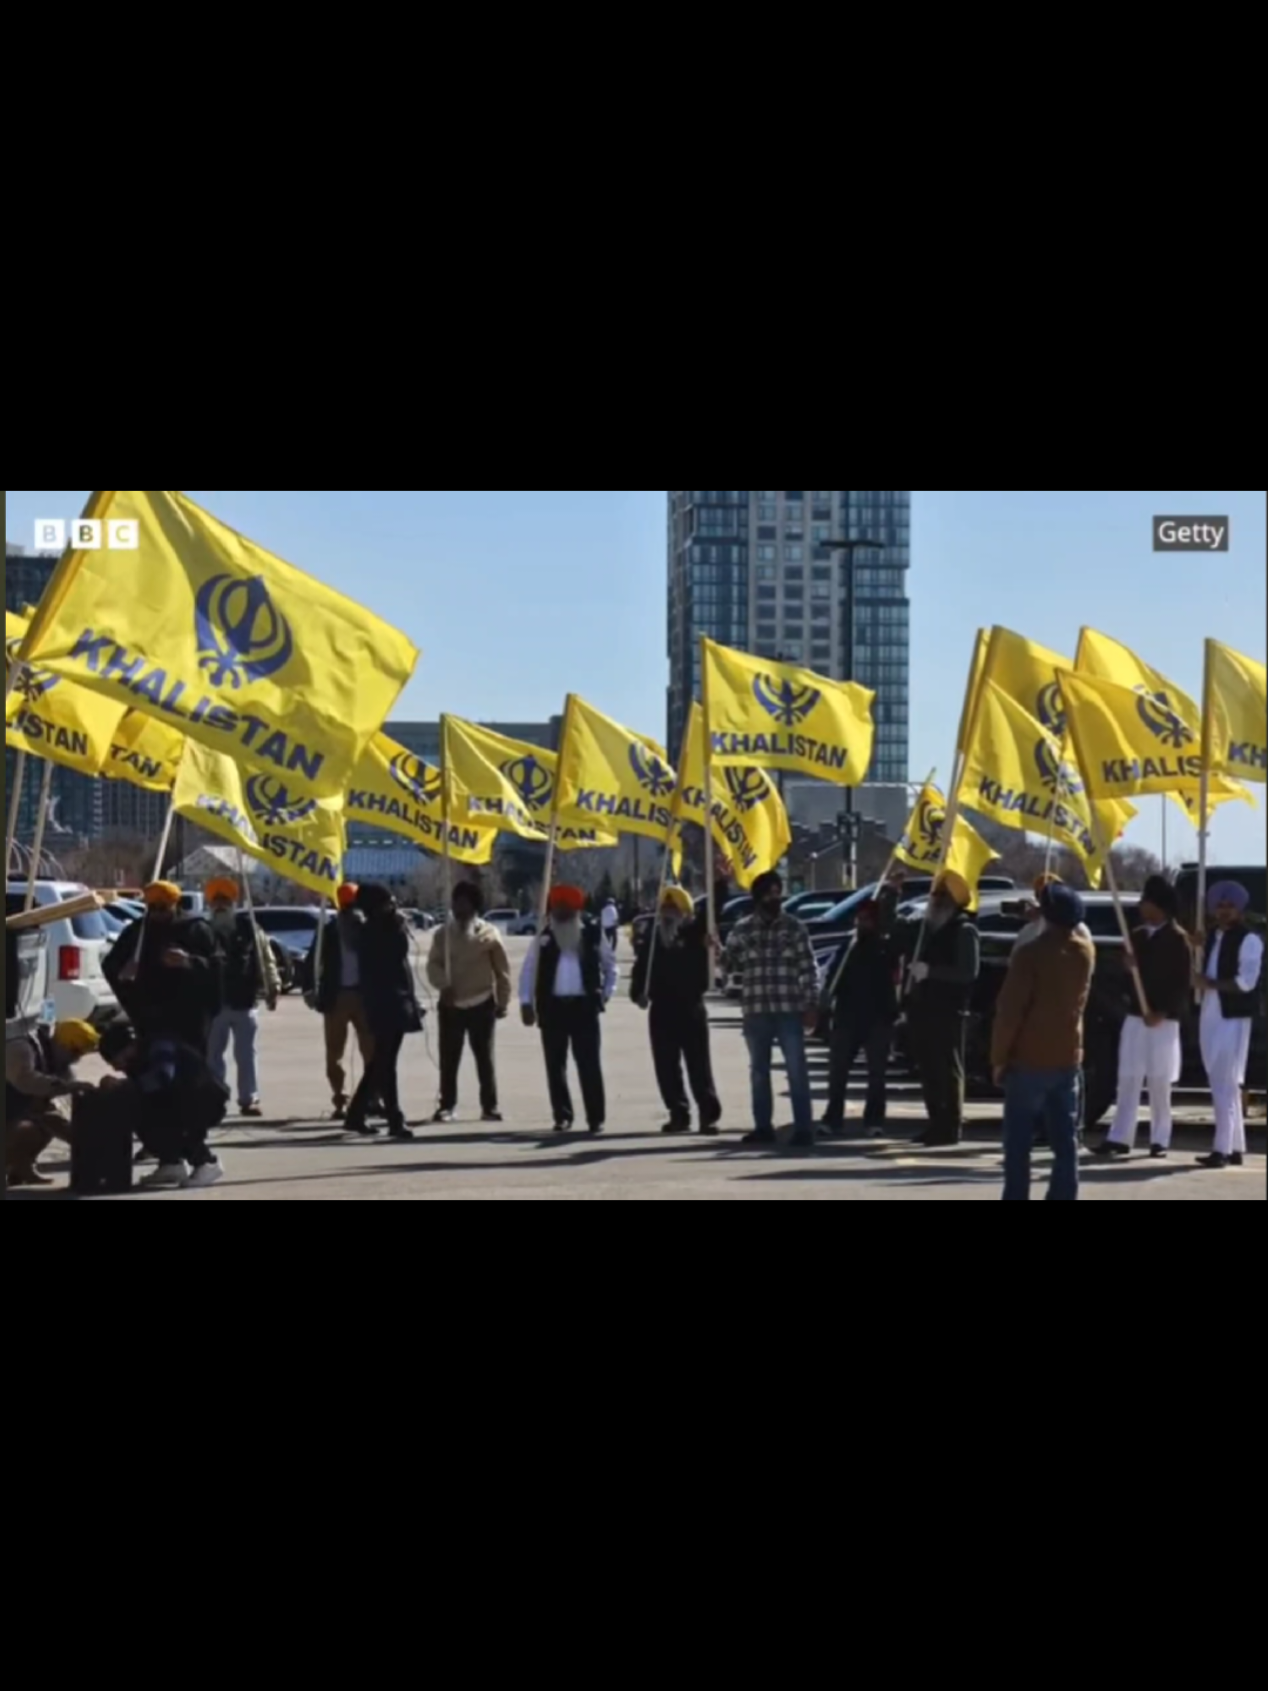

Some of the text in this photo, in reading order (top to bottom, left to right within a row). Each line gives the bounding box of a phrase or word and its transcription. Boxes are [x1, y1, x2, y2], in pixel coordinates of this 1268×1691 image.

[68, 628, 326, 781] KHALISTAN
[6, 710, 88, 756] ISTAN
[711, 731, 848, 770] KHALISTAN
[348, 788, 479, 850] KHALISTAN
